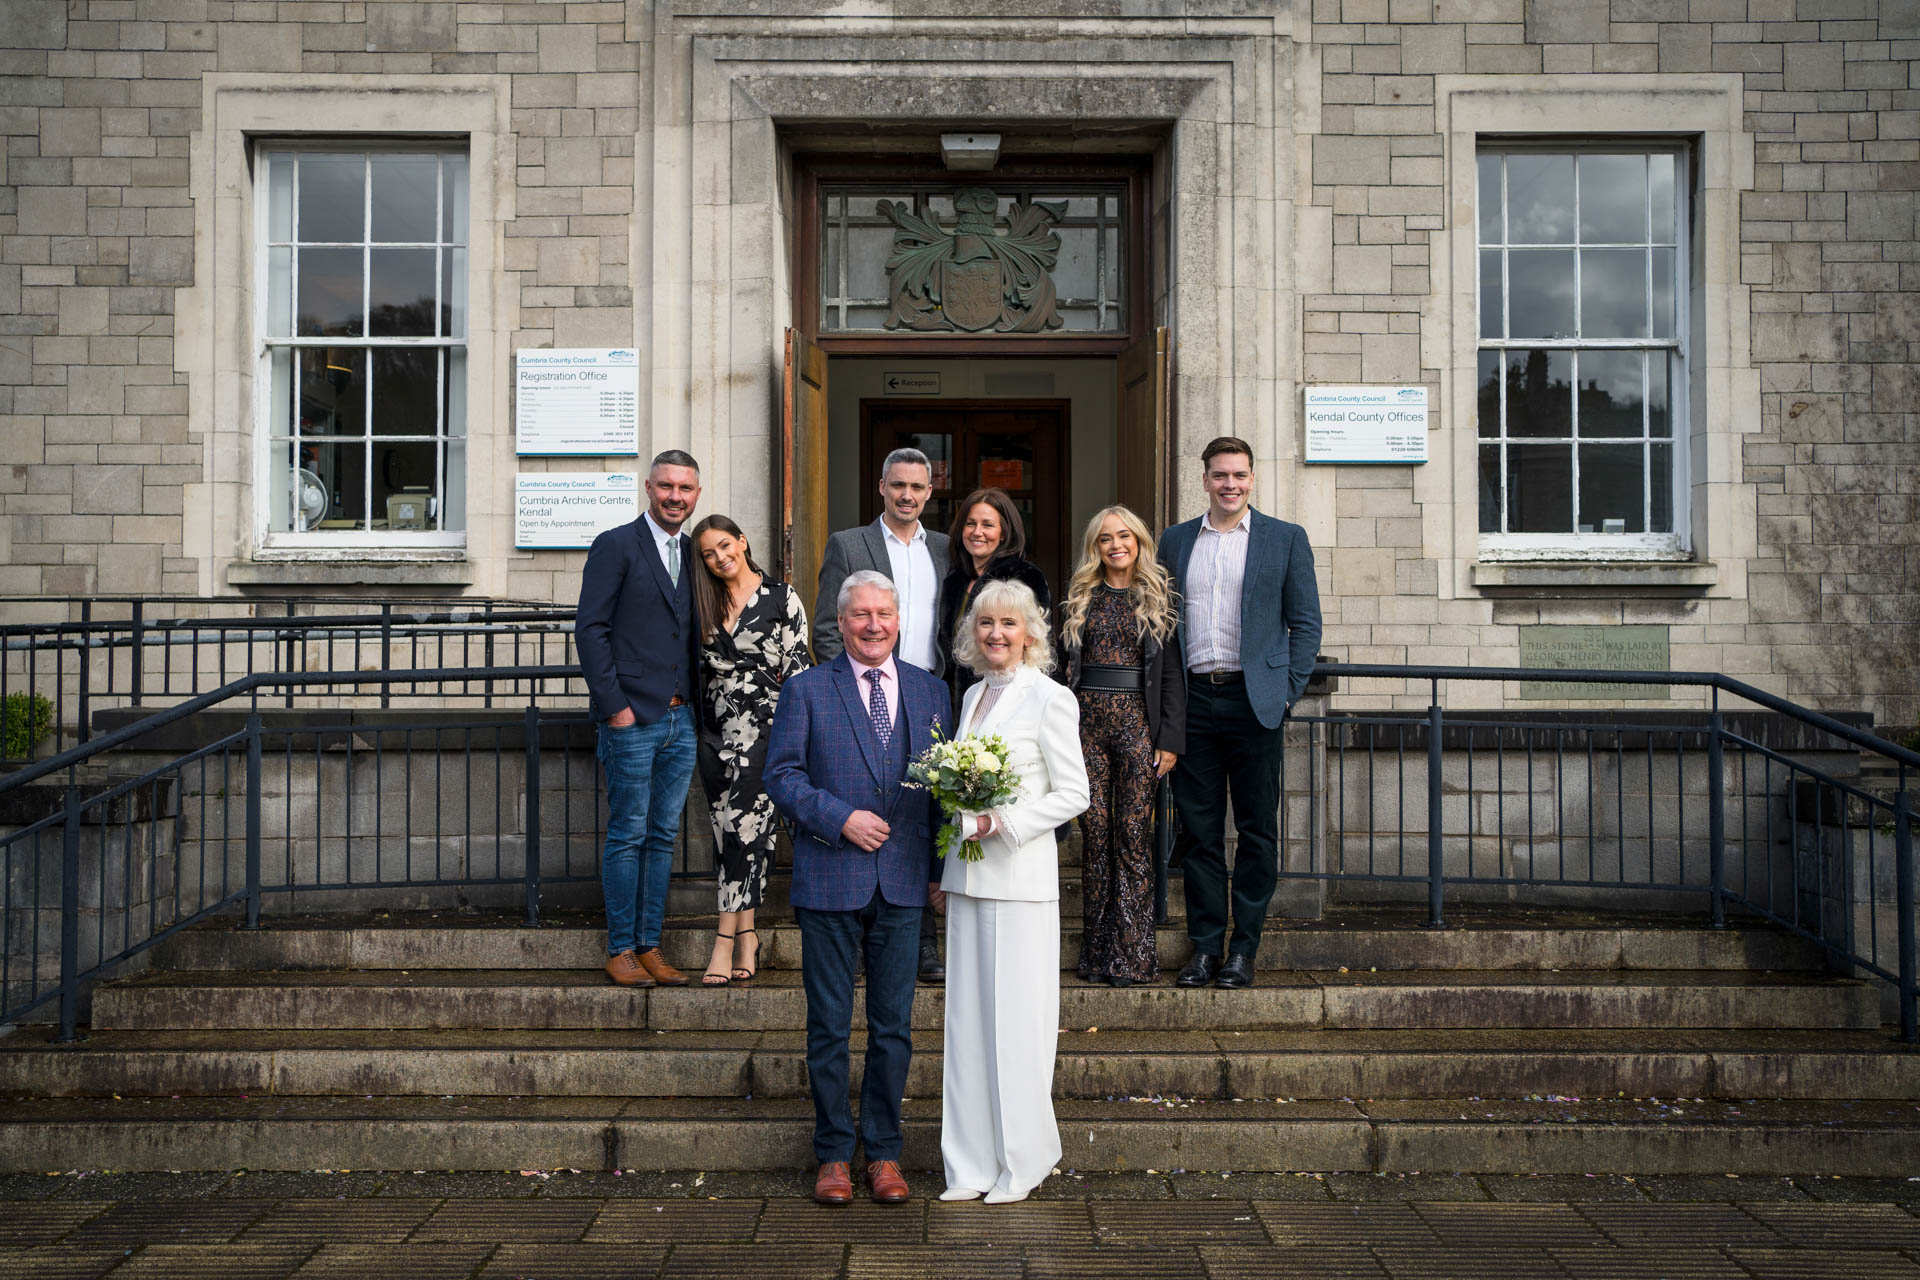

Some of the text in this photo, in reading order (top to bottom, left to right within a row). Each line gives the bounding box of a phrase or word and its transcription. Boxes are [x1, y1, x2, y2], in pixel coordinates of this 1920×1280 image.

[548, 357, 571, 365] County
[520, 371, 607, 382] Registration Office
[901, 379, 936, 387] Reception
[1310, 412, 1424, 424] Kendal County Offices
[520, 496, 634, 506] Cumbria Archive Centre,
[519, 508, 552, 516] Kendal
[541, 520, 549, 528] by
[550, 520, 595, 528] Appointment
[1526, 642, 1548, 650] THIS
[1552, 642, 1583, 650] STONE
[1605, 642, 1624, 650] WAS
[1526, 652, 1663, 661] GEORGE HENRY PATTINSON
